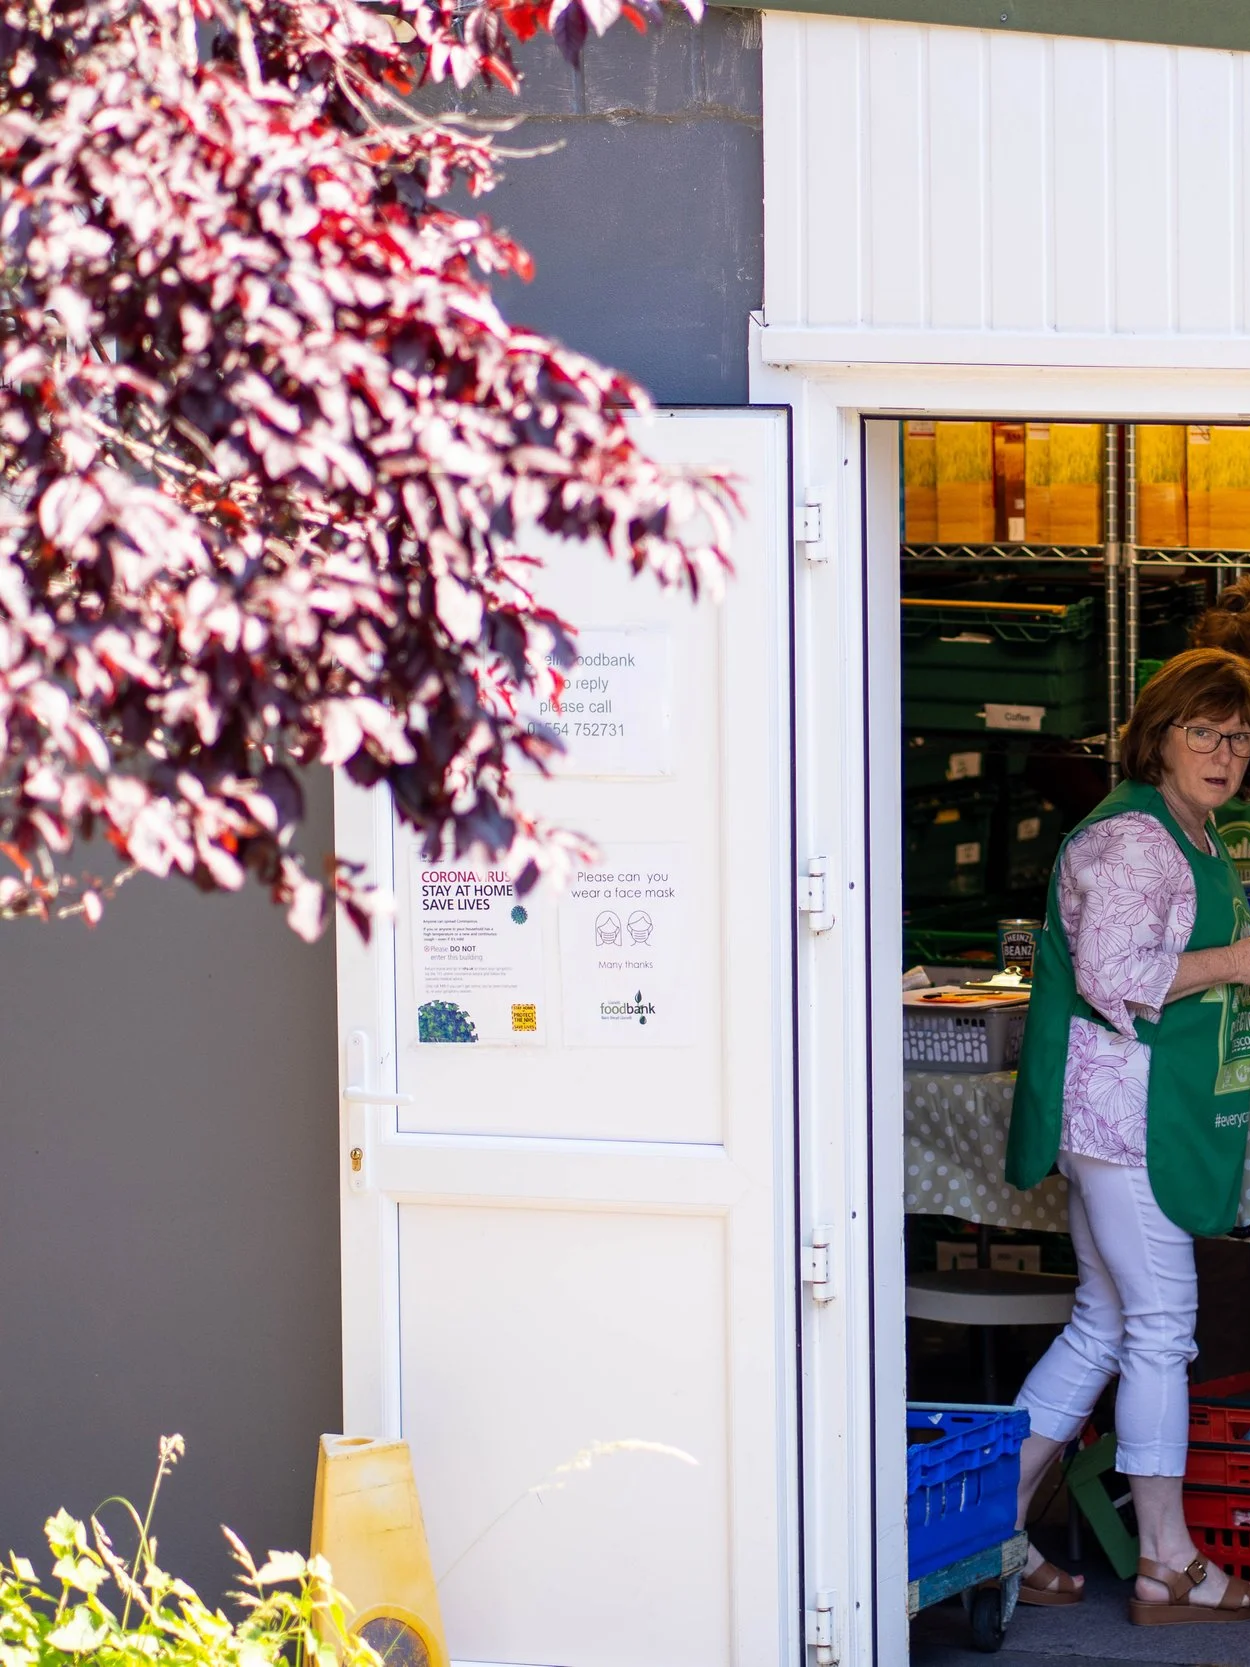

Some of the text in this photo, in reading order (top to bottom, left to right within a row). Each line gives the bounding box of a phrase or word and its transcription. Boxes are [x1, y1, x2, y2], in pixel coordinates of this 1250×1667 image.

[576, 653, 636, 666] oodbank
[576, 676, 609, 693] reply
[589, 699, 612, 713] call
[1004, 712, 1031, 722] Coffee
[574, 723, 624, 736] 752731
[577, 872, 669, 884] Please can you
[422, 885, 513, 896] STAY AT HOME
[571, 887, 675, 898] wear a face mask
[422, 899, 490, 910] SAVE LIVES
[1007, 933, 1030, 943] HEINZ
[1004, 945, 1032, 956] BEANZ
[599, 960, 653, 970] Many thanks
[600, 1002, 656, 1014] foodbank
